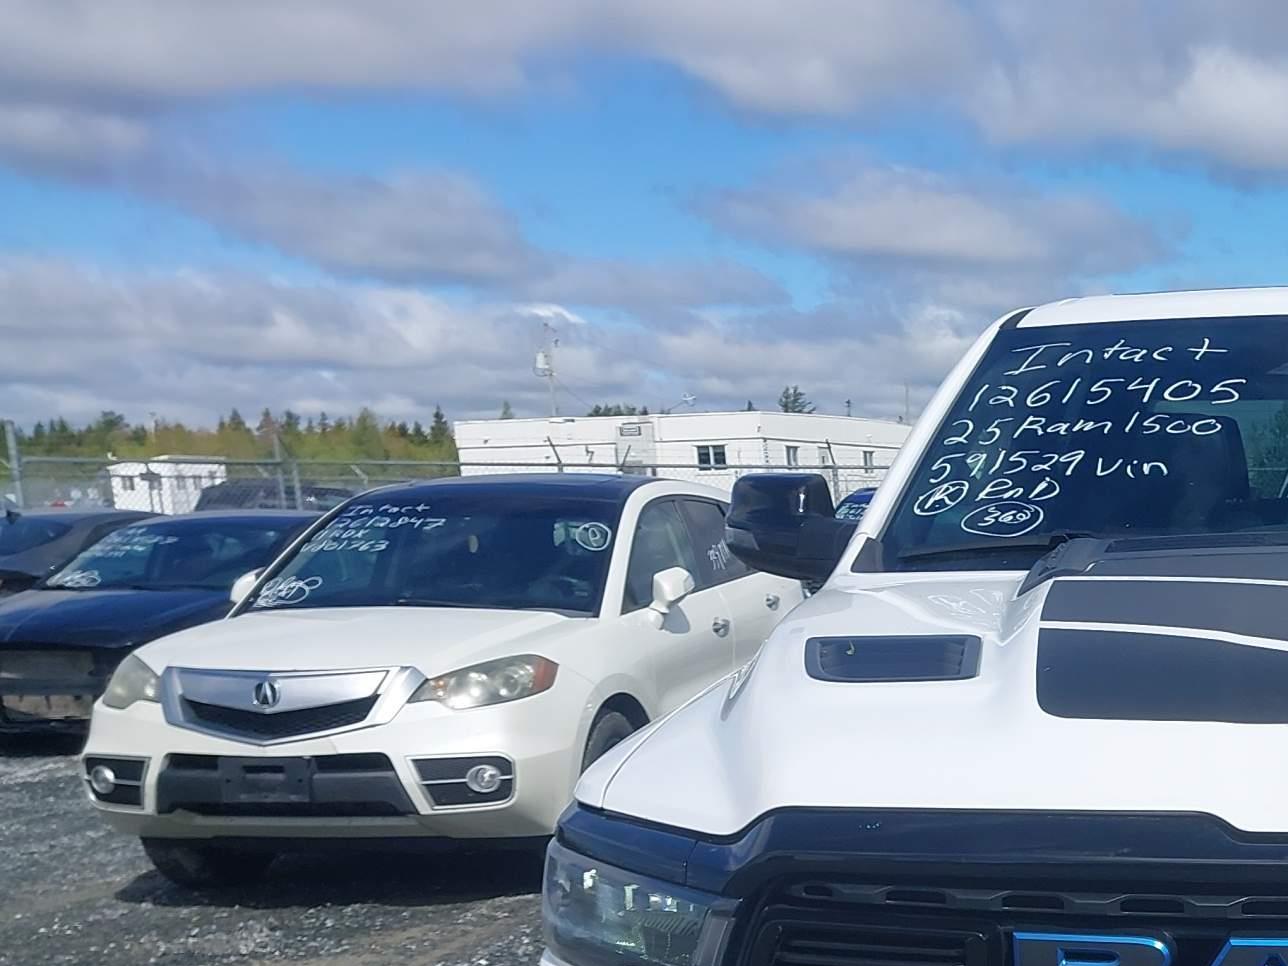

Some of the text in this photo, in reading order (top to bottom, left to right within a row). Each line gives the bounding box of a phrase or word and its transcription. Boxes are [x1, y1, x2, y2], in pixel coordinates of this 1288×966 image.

[1004, 337, 1229, 376] Intact
[968, 378, 1248, 411] 12615405
[944, 420, 1014, 446] 25
[1123, 411, 1223, 436] 1500
[929, 449, 1086, 484] 591529
